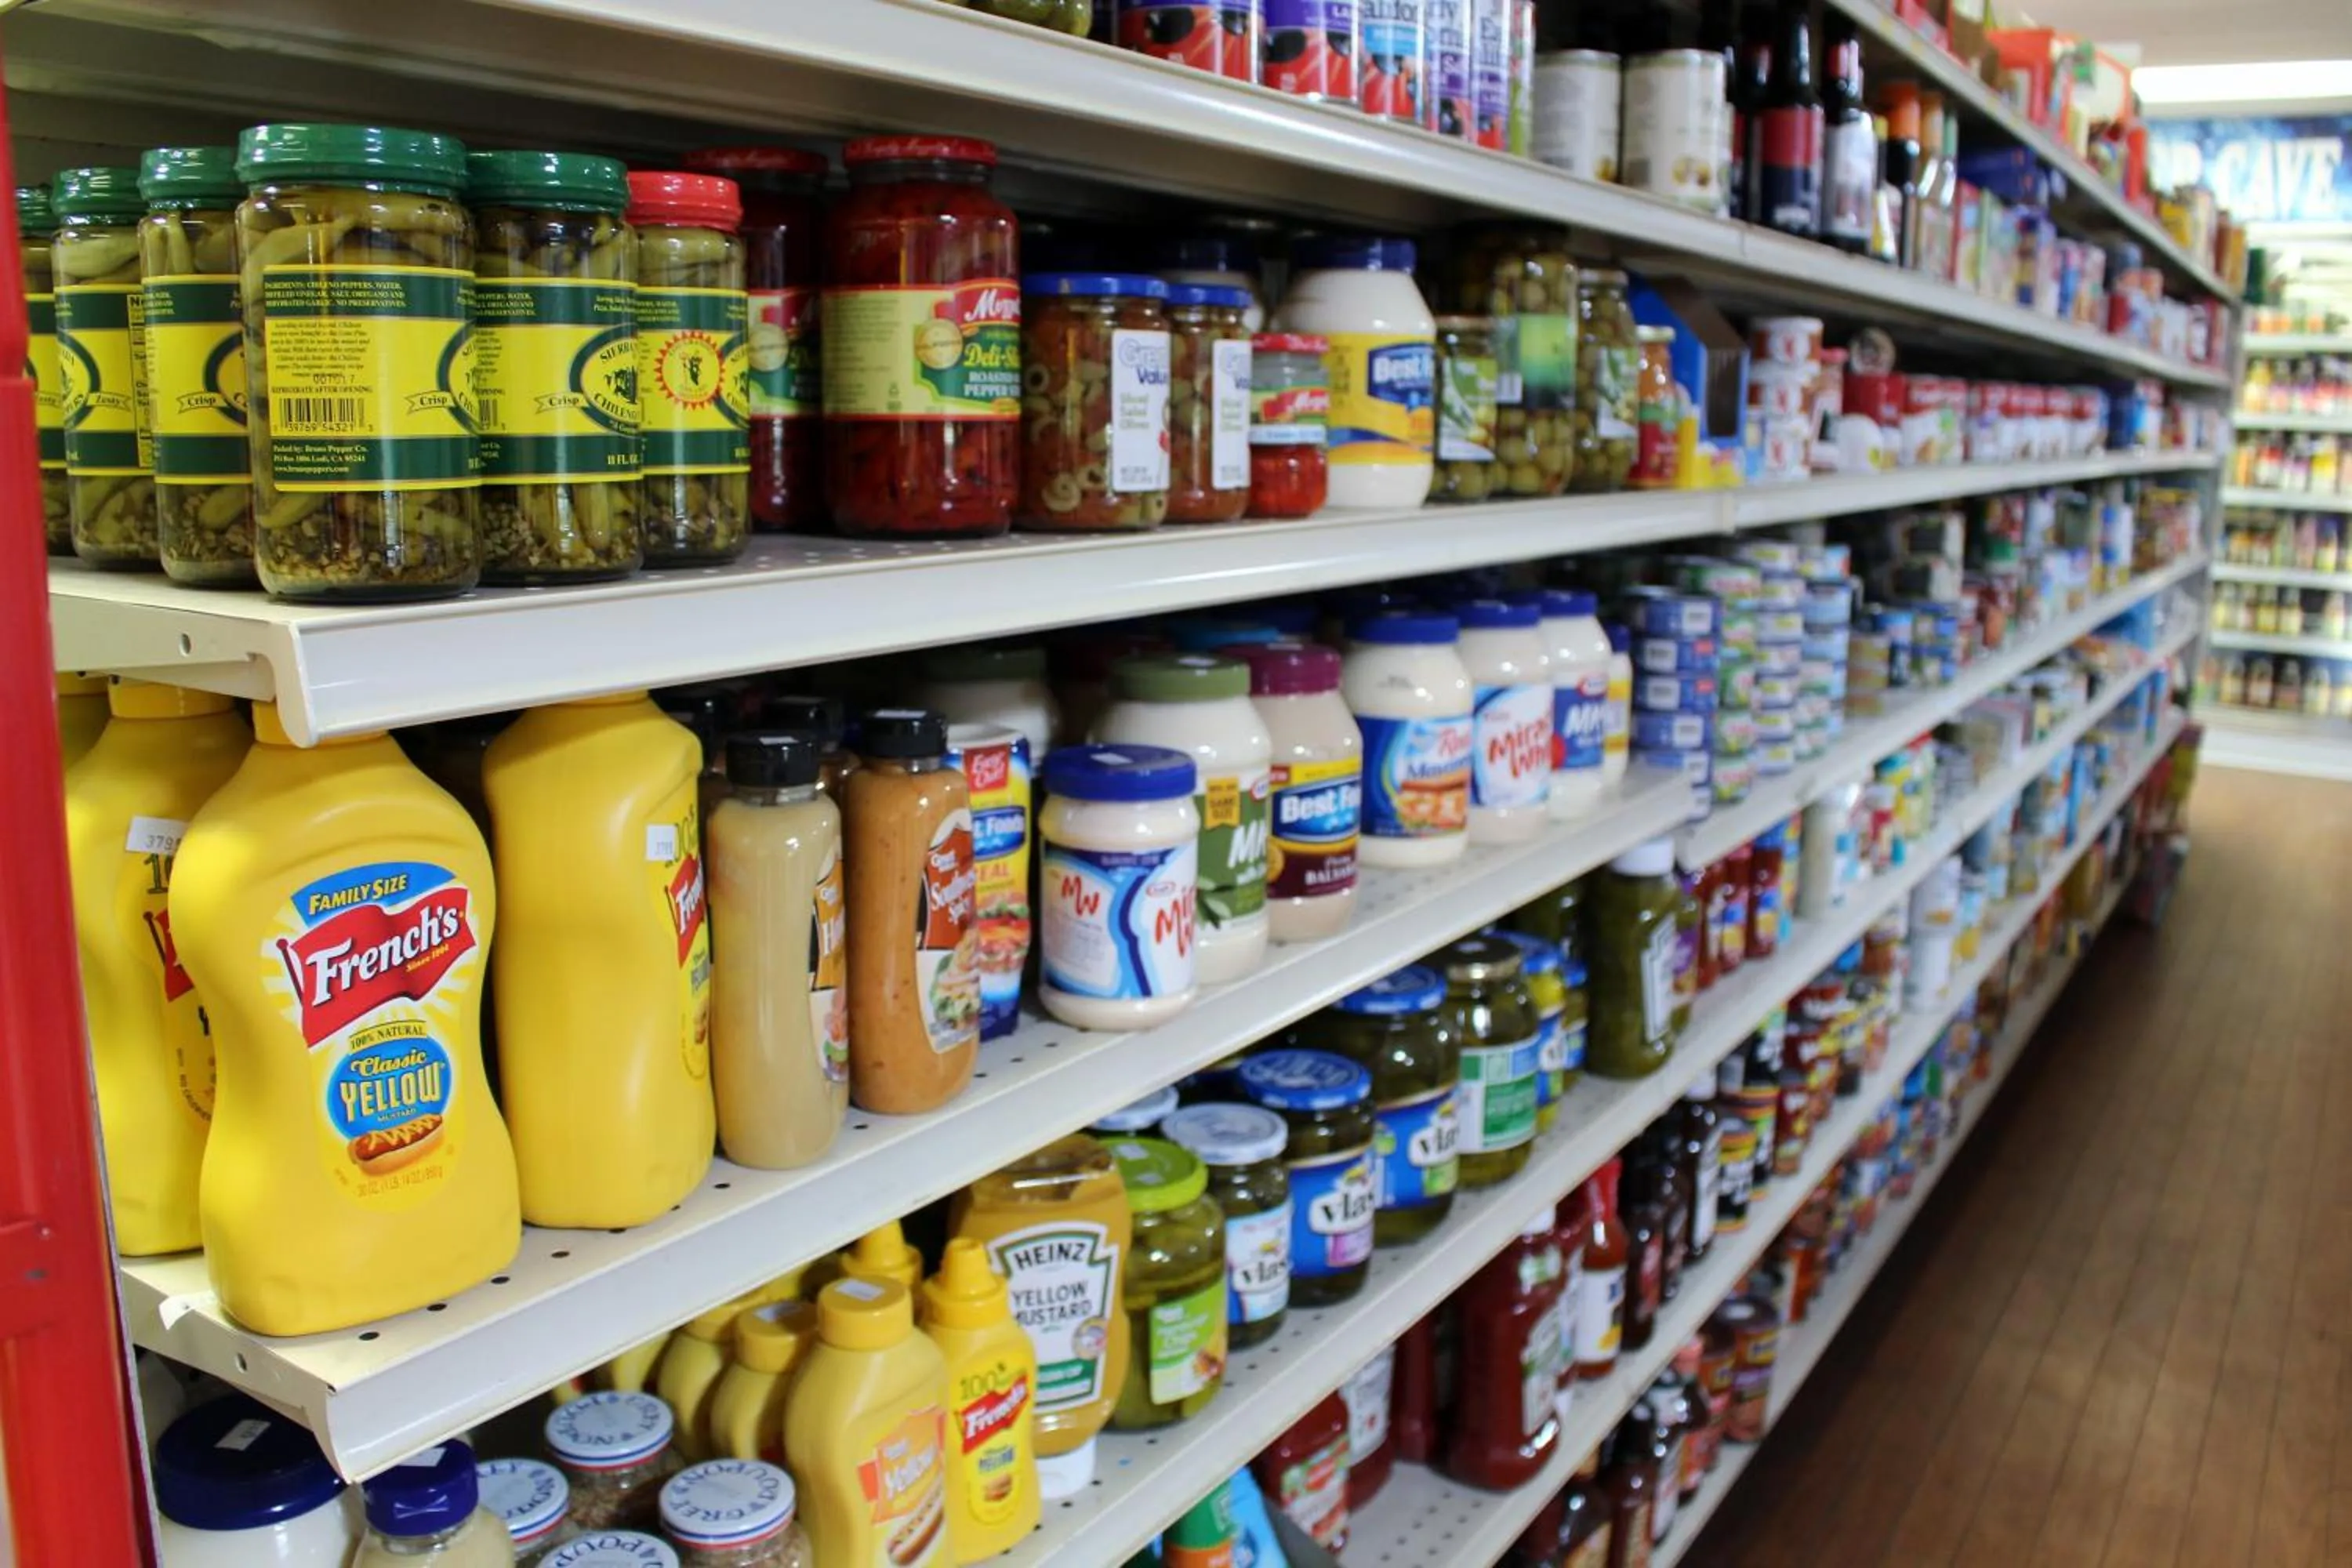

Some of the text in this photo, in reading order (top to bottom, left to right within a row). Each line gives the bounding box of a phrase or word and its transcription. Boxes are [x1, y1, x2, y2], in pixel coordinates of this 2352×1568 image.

[187, 396, 217, 407] Crisp
[419, 395, 448, 406] Crisp
[549, 395, 579, 407] Crisp
[1280, 788, 1334, 823] Best
[309, 874, 408, 916] FAMILY SIZE
[305, 906, 459, 1007] French's
[377, 1024, 425, 1039] NATURAL
[350, 1048, 426, 1076] Classic
[339, 1061, 441, 1123] YELLOW
[1014, 1241, 1087, 1270] HEINZ
[1011, 1279, 1088, 1307] YELLOW
